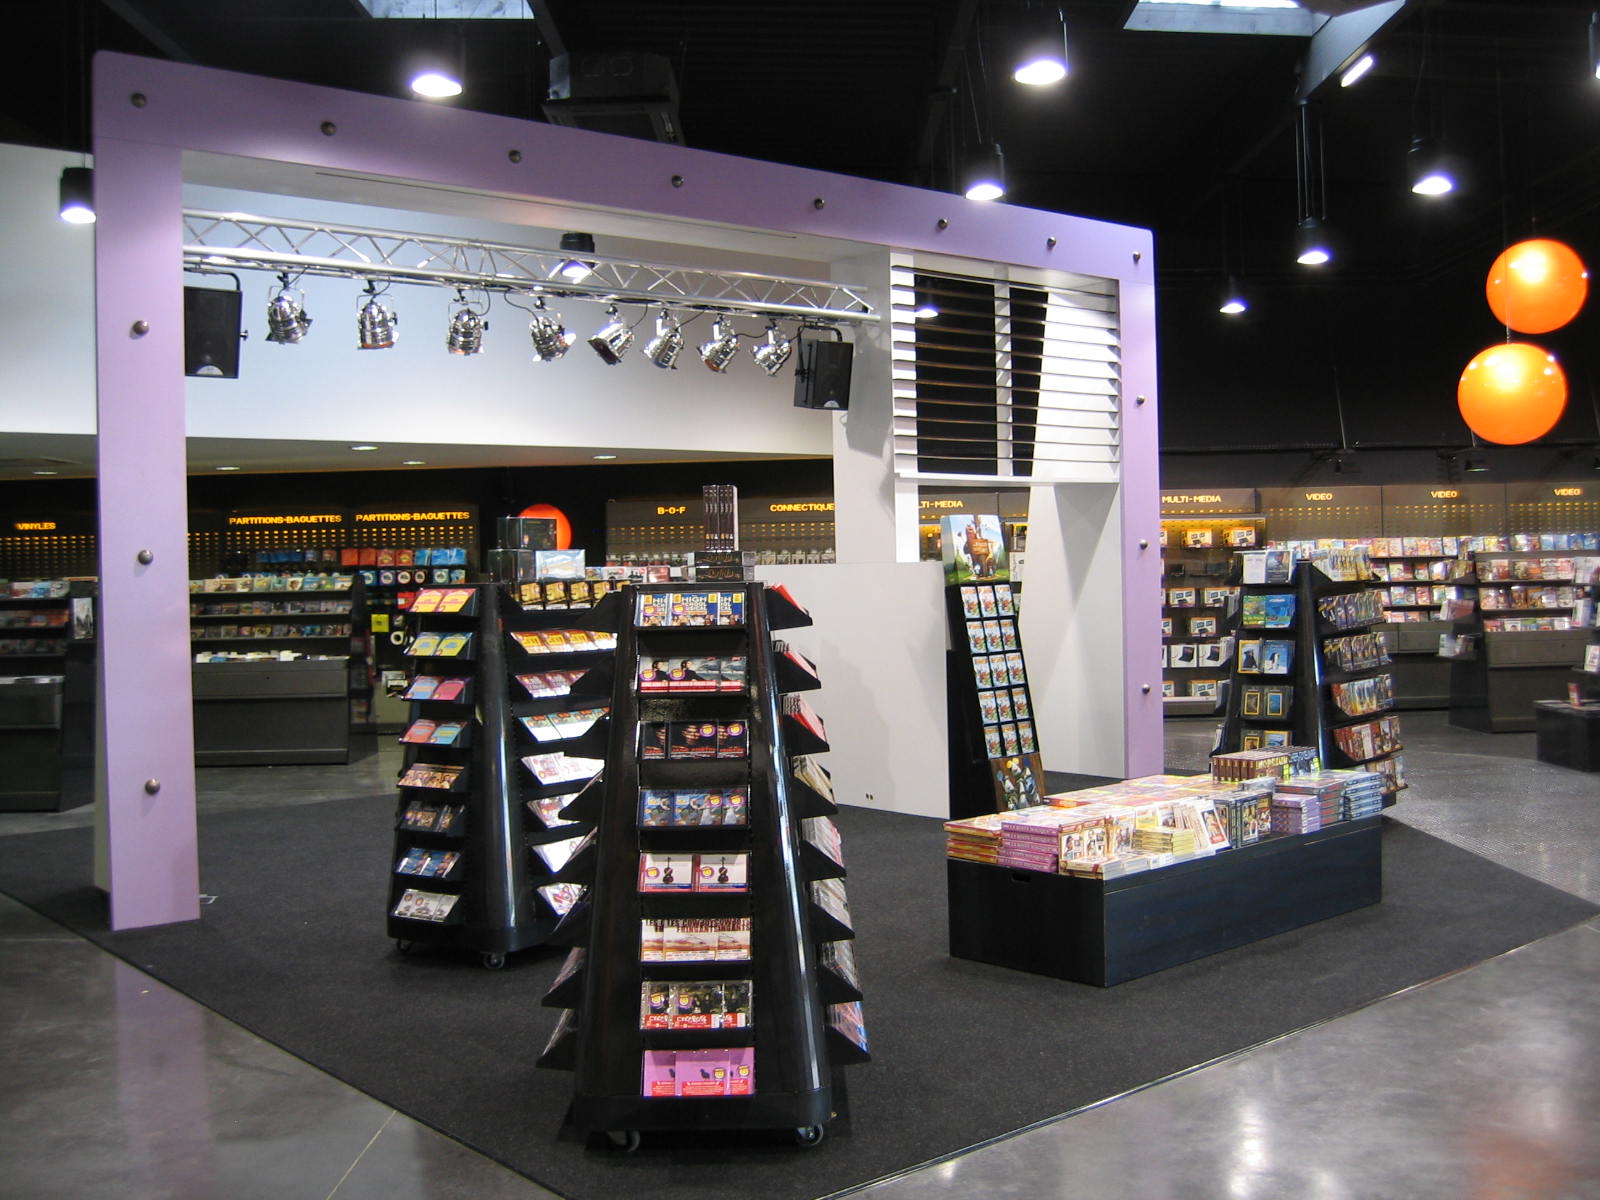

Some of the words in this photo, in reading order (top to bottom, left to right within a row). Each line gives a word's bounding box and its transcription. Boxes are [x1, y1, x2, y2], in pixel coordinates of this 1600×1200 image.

[1431, 489, 1460, 498] VIDEO
[1554, 487, 1583, 496] VIDEO
[1161, 495, 1222, 504] MULTI-MEDIA
[1305, 492, 1334, 501] VIDEO
[656, 505, 687, 515] B-O-F
[229, 515, 343, 525] PARTITIONS-BAGUETTES
[356, 512, 470, 522] PARTITIONS-BAGUETTES
[16, 521, 57, 531] VINYLES
